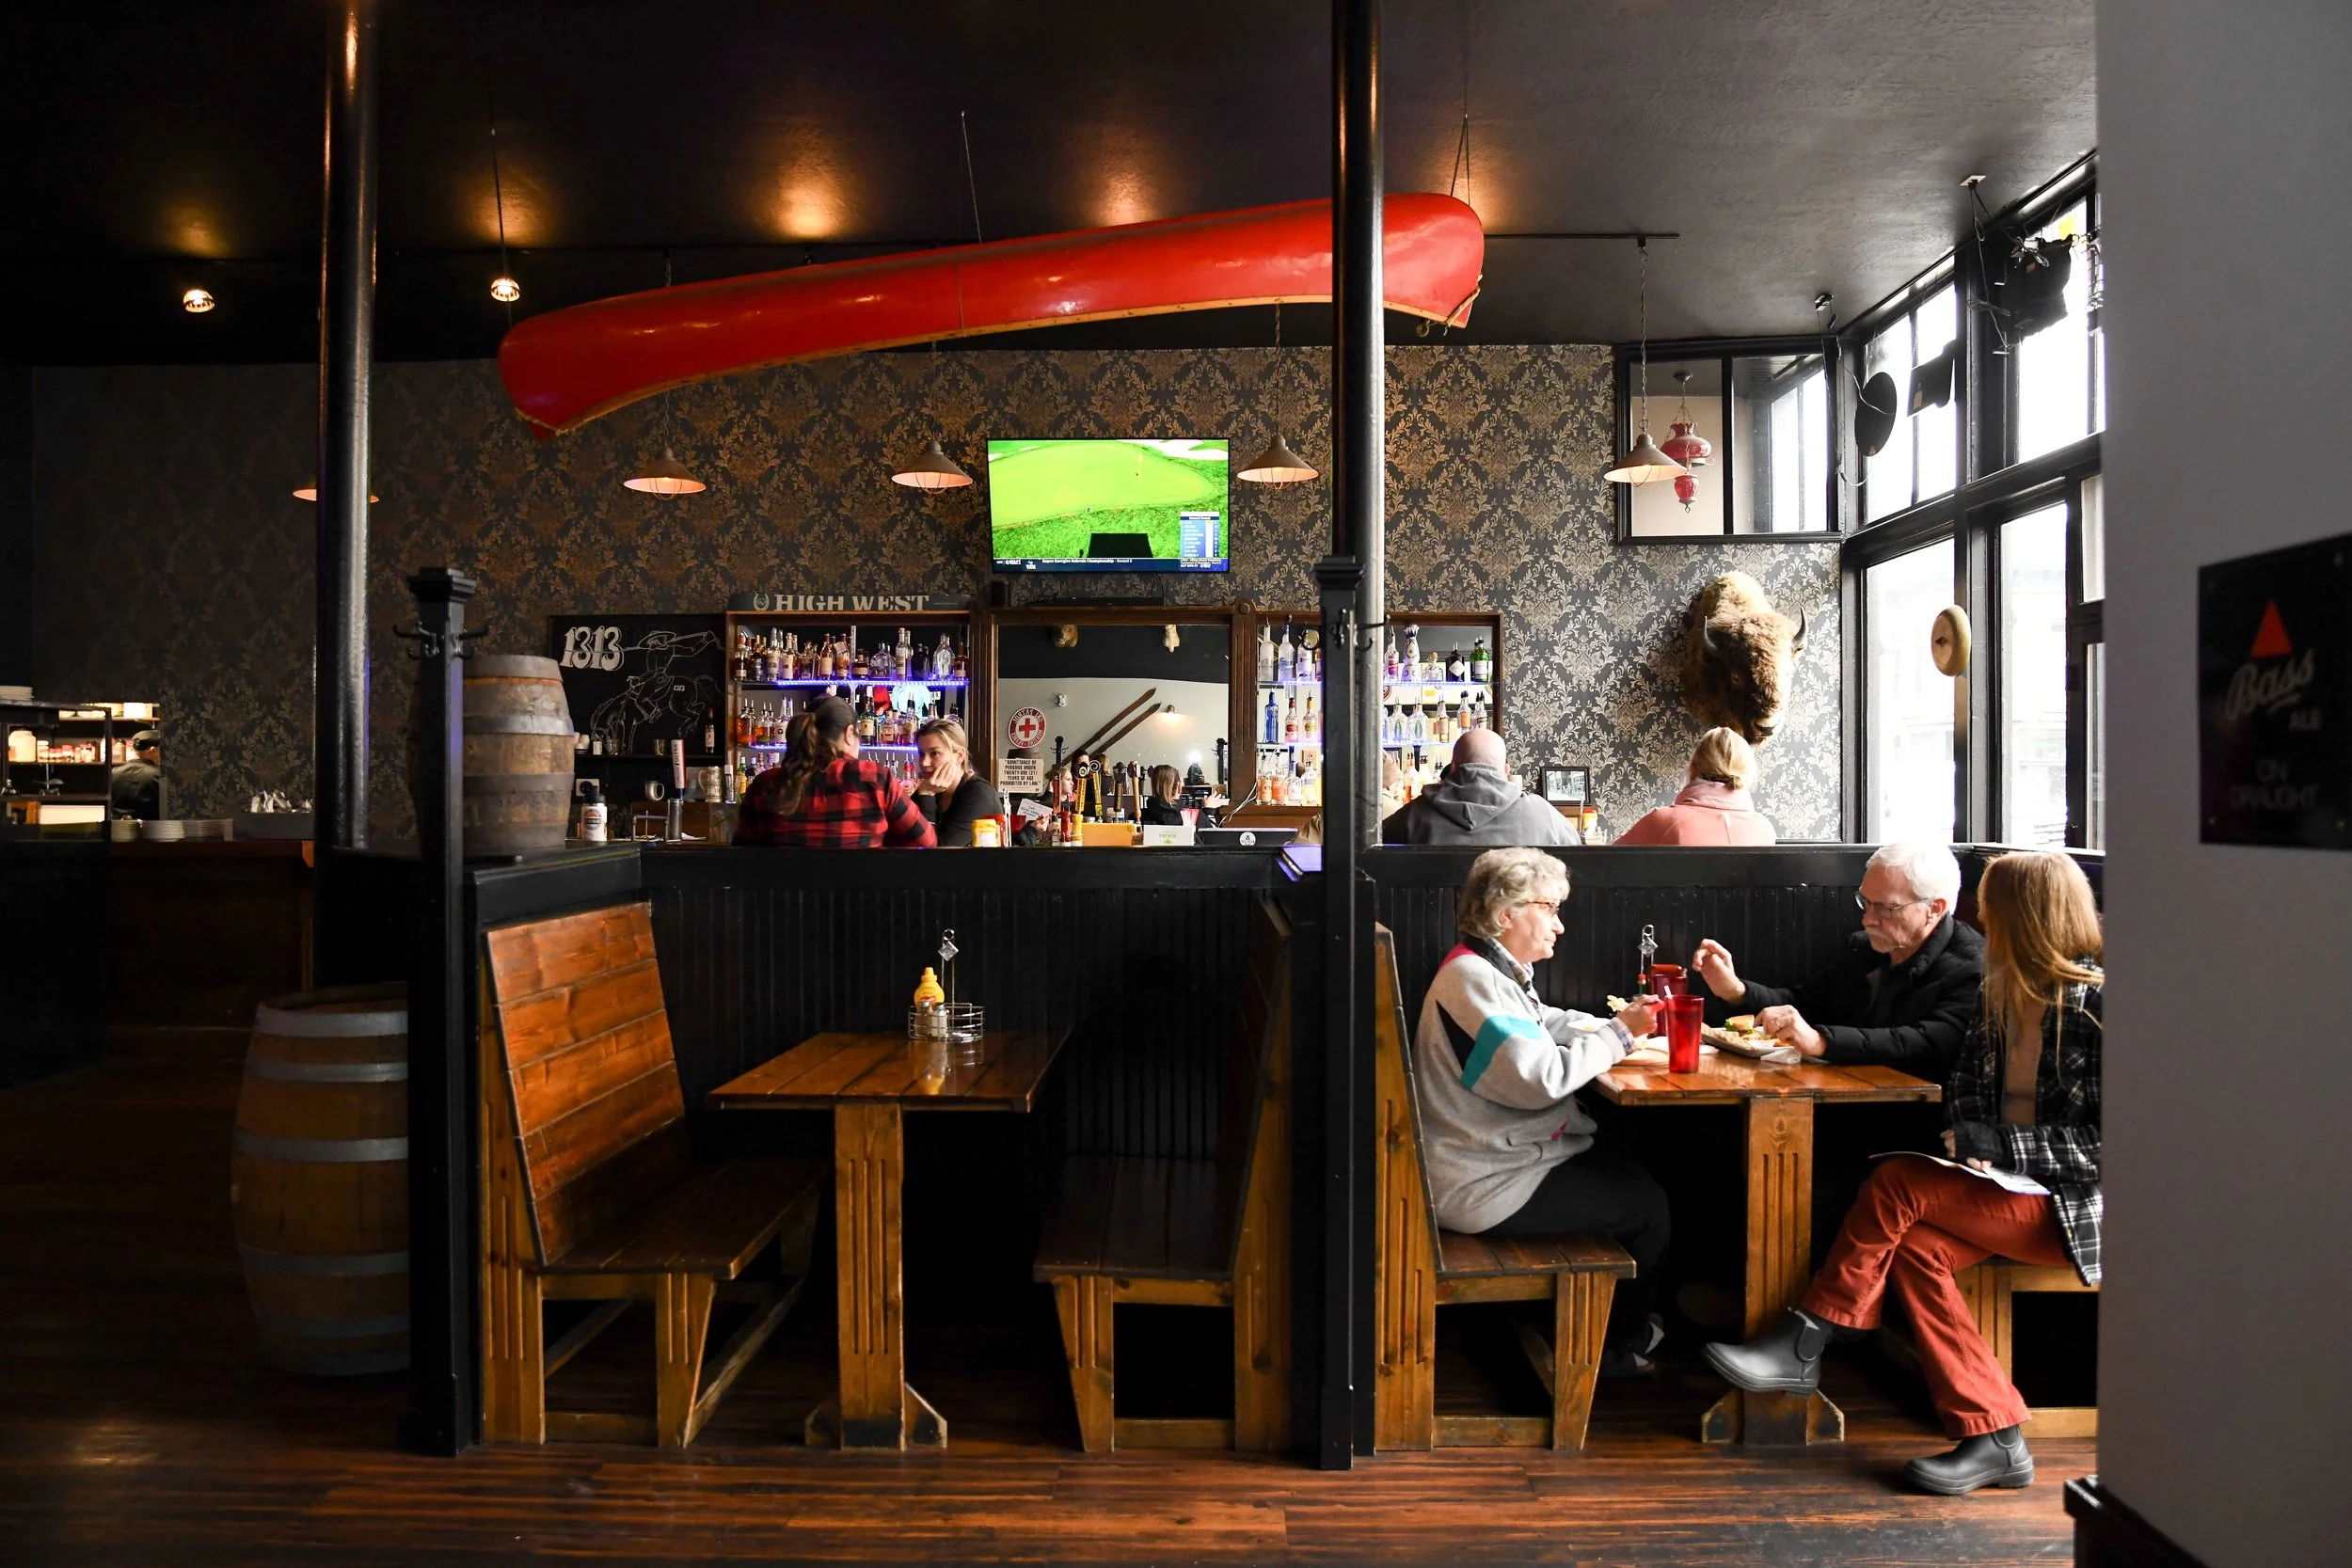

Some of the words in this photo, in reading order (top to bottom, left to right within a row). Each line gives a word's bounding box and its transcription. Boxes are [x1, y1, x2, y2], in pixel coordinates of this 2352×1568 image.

[773, 594, 845, 611] HIGH
[851, 594, 930, 611] WEST
[559, 625, 625, 671] 1313
[2225, 646, 2316, 722] Bass
[2288, 706, 2323, 732] ALE
[2254, 757, 2289, 783] ON
